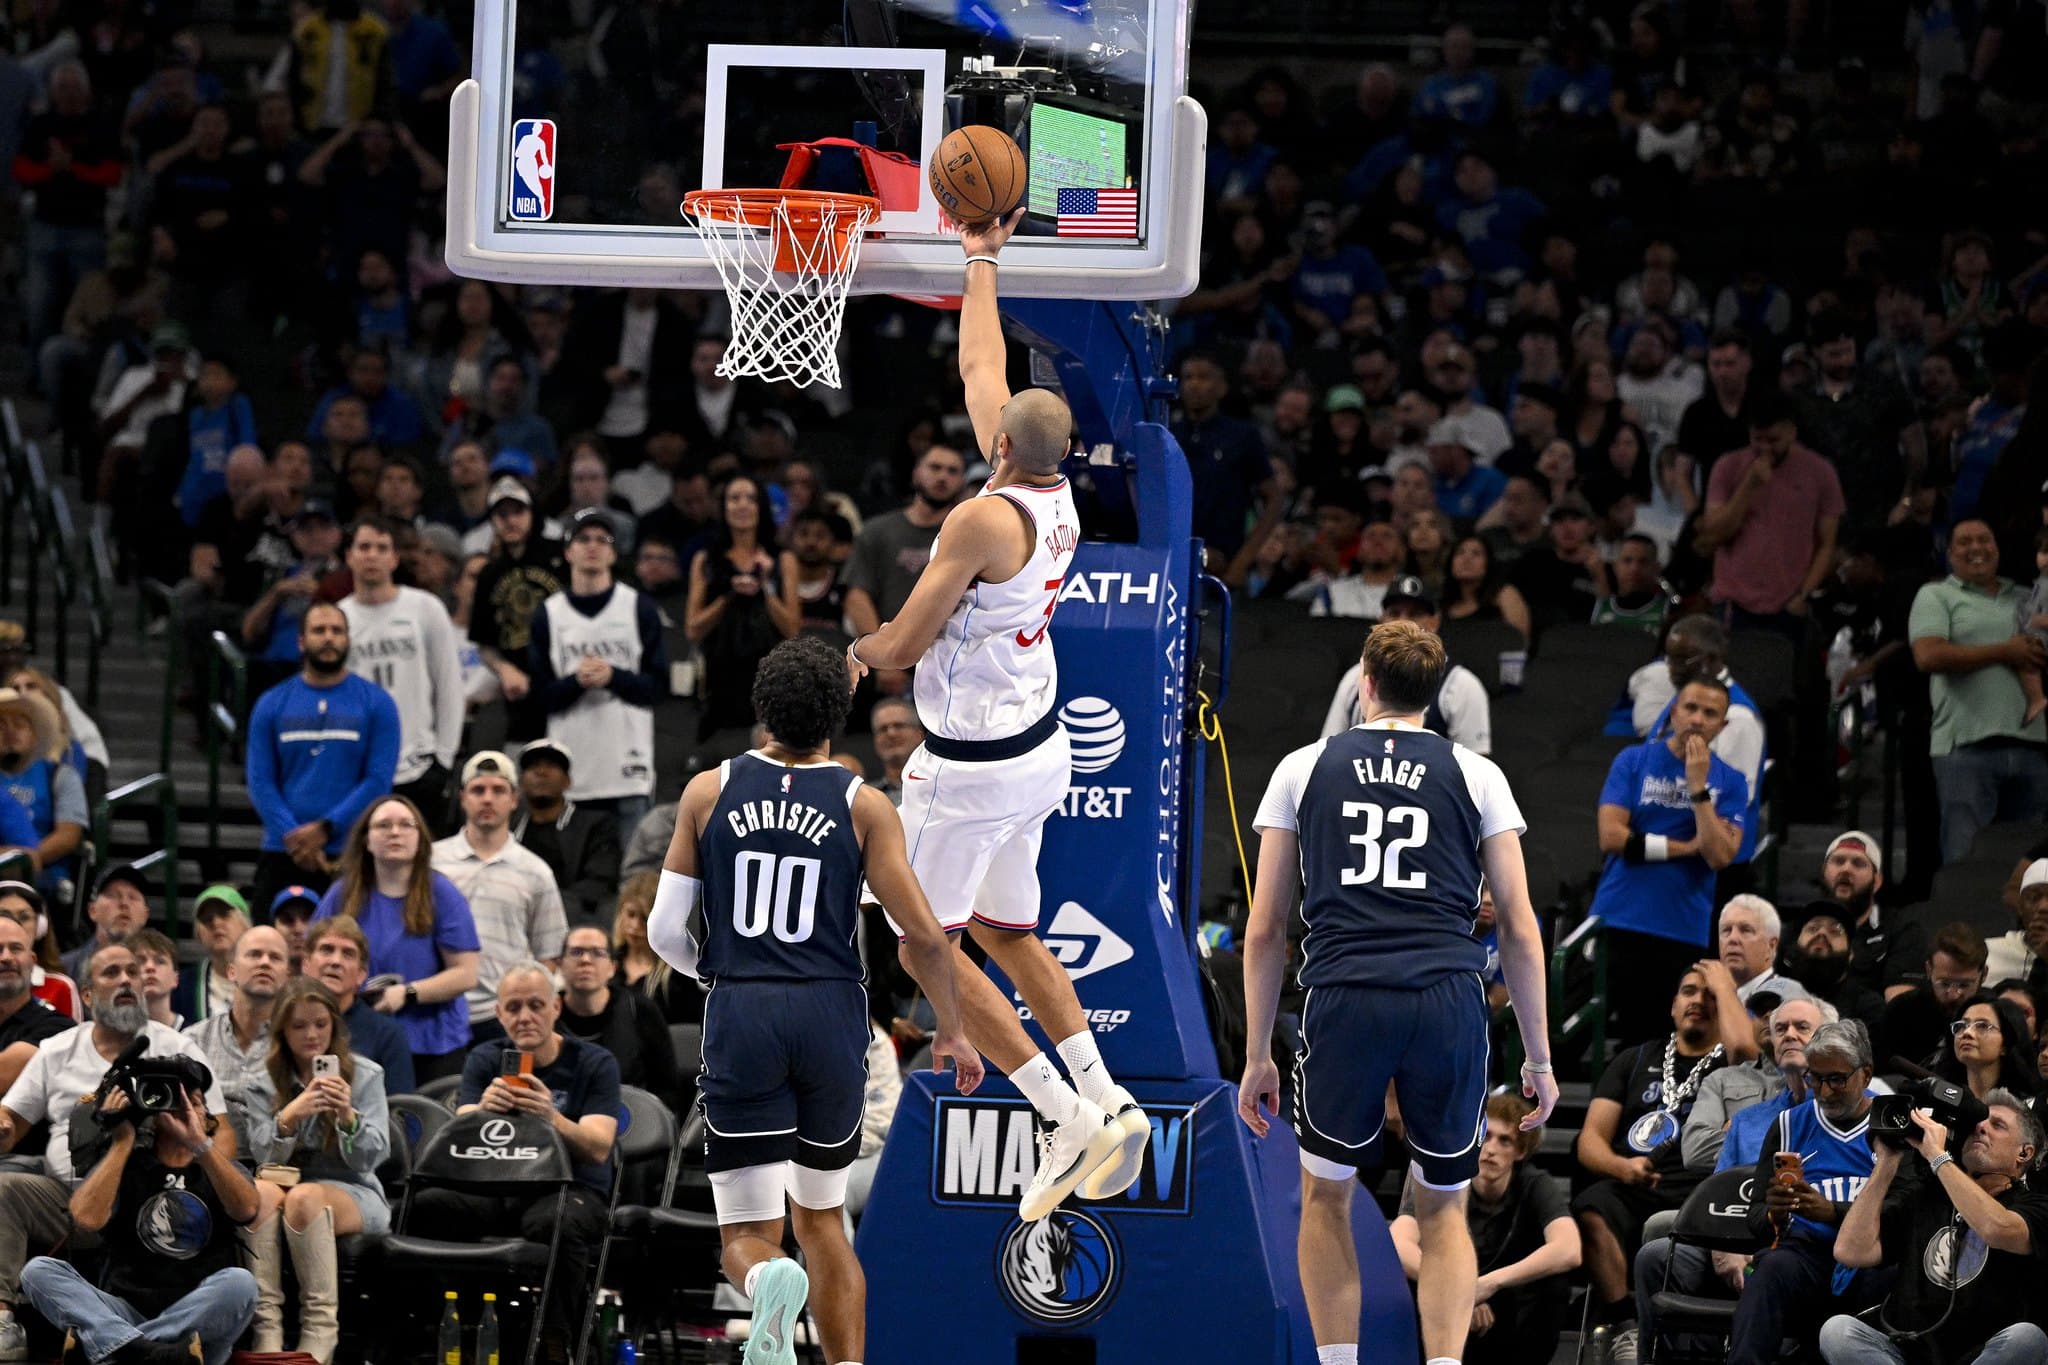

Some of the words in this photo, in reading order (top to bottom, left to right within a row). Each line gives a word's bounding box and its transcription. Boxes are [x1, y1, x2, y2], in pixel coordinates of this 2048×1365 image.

[516, 197, 537, 214] NBA
[1057, 572, 1159, 604] ATH
[1157, 579, 1178, 894] CHOCTAW
[1352, 757, 1427, 791] FLAGG
[727, 800, 838, 847] CHRISTIE
[1341, 801, 1430, 890] 32
[733, 850, 822, 943] 00
[449, 1144, 539, 1160] LEXUS
